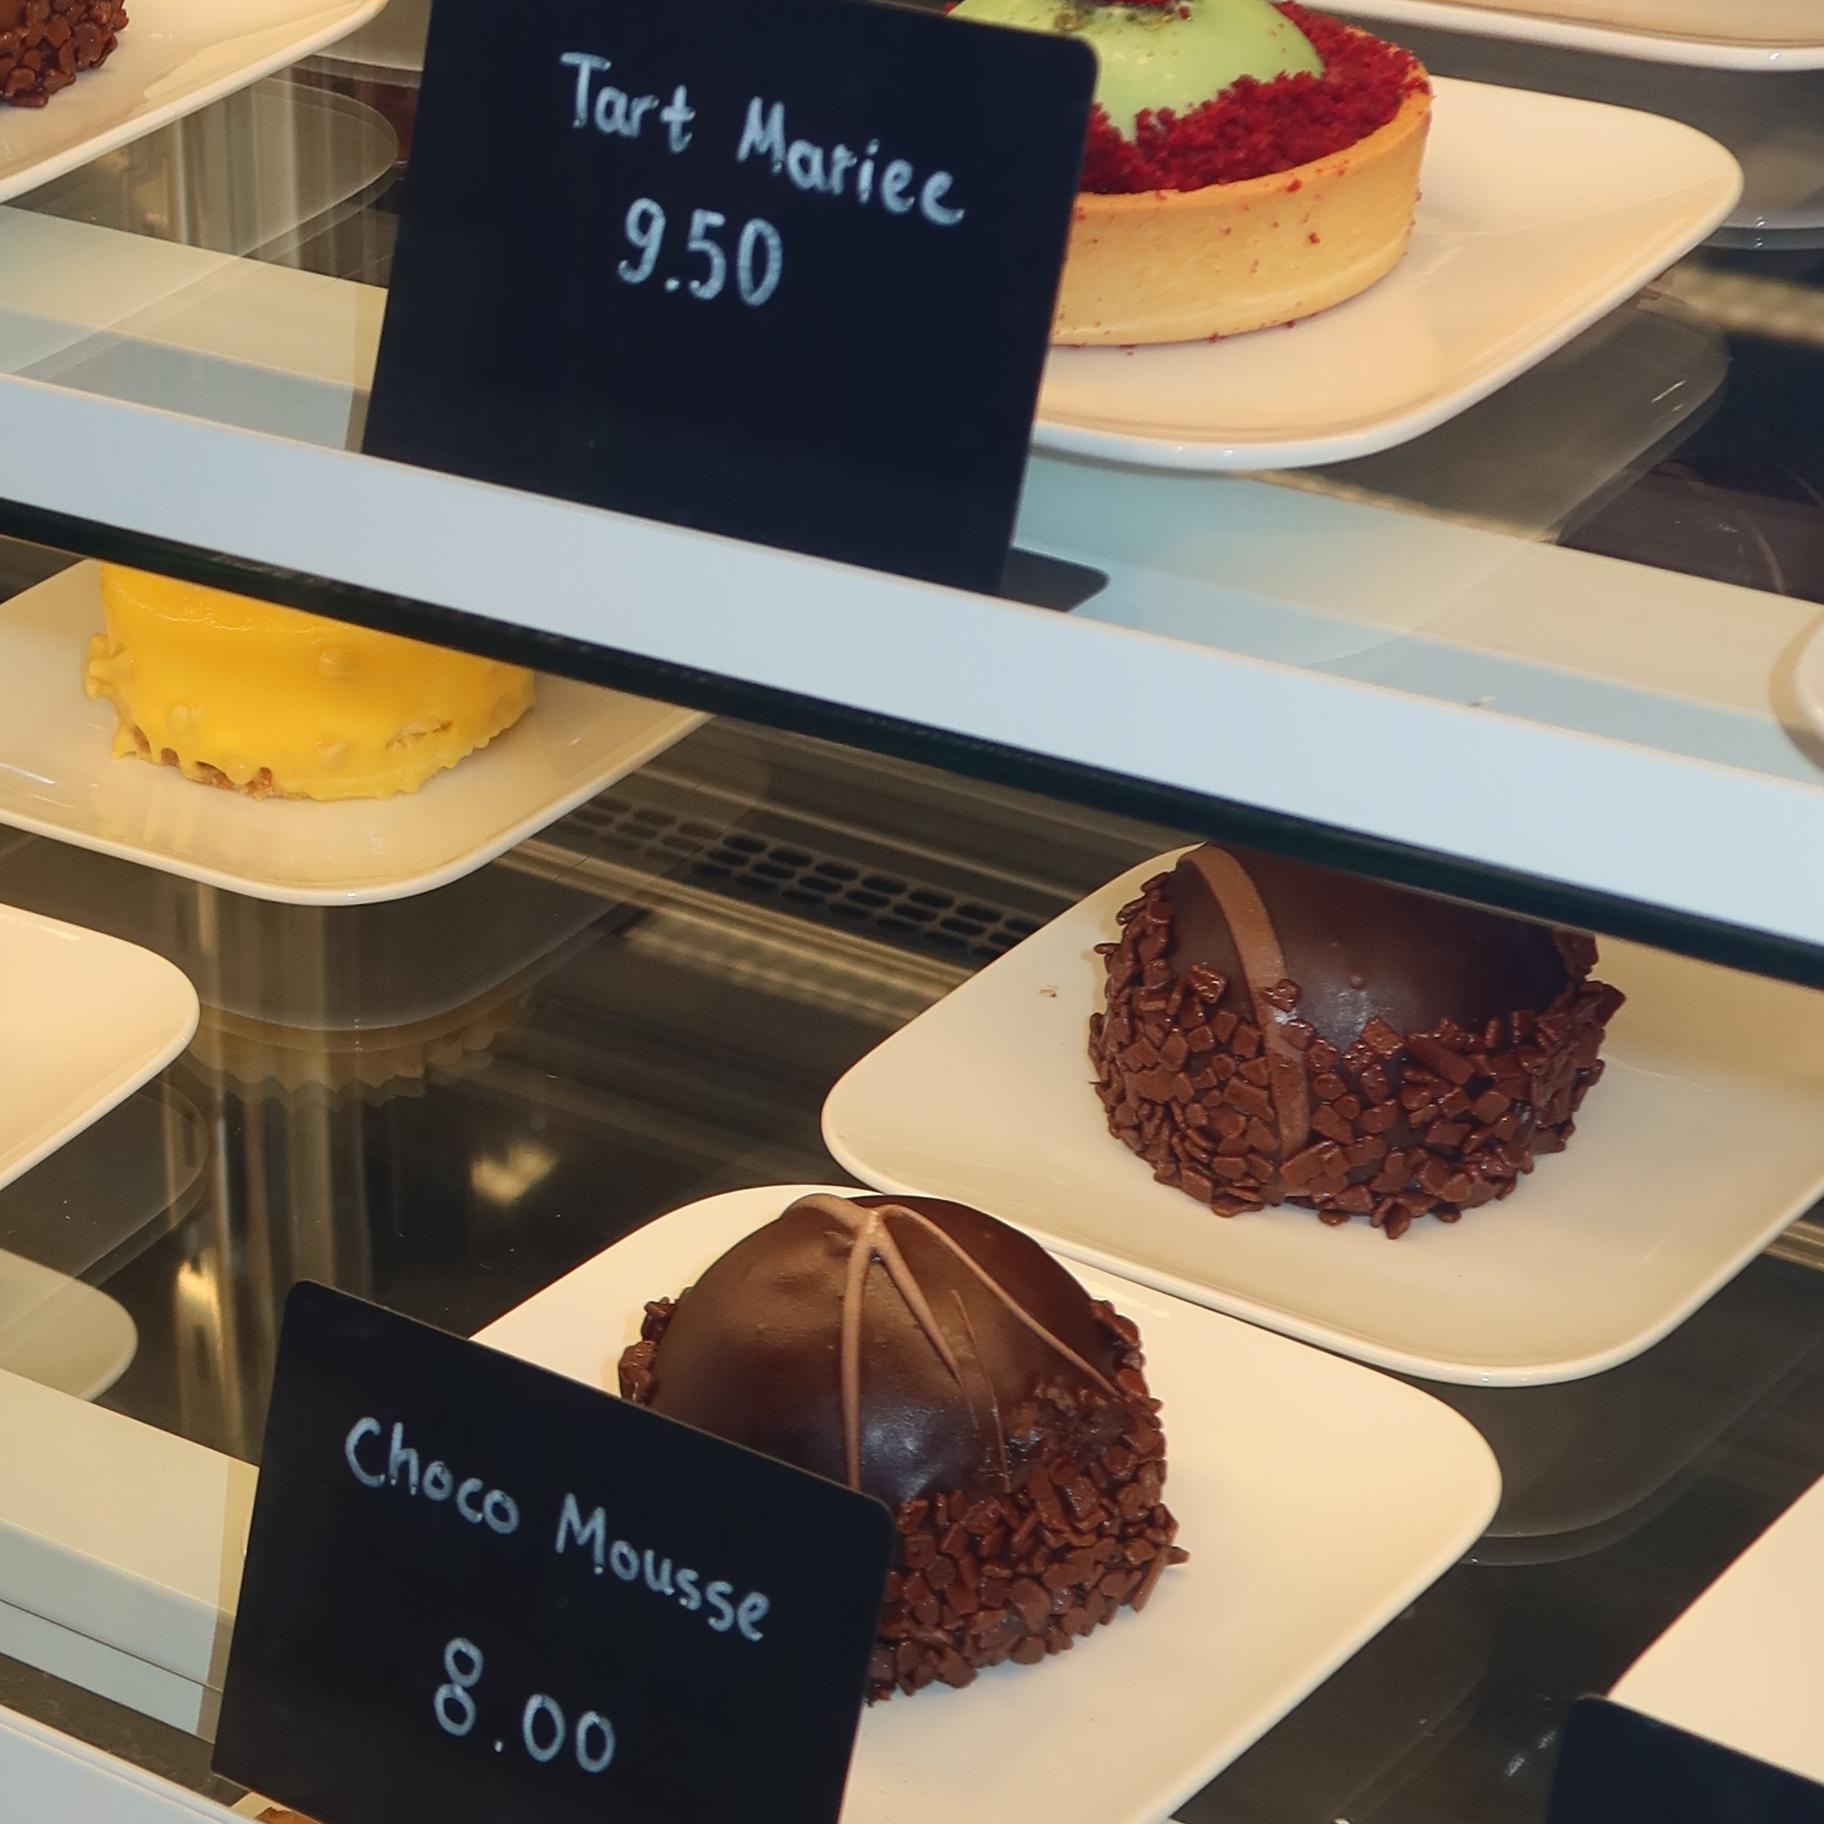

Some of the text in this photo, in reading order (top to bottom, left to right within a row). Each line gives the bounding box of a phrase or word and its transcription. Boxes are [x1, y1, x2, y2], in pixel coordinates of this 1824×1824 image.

[560, 53, 695, 154] Tart
[619, 199, 783, 306] 9.50
[346, 1419, 769, 1642] Choco Mousse
[435, 1638, 616, 1773] 8.00
